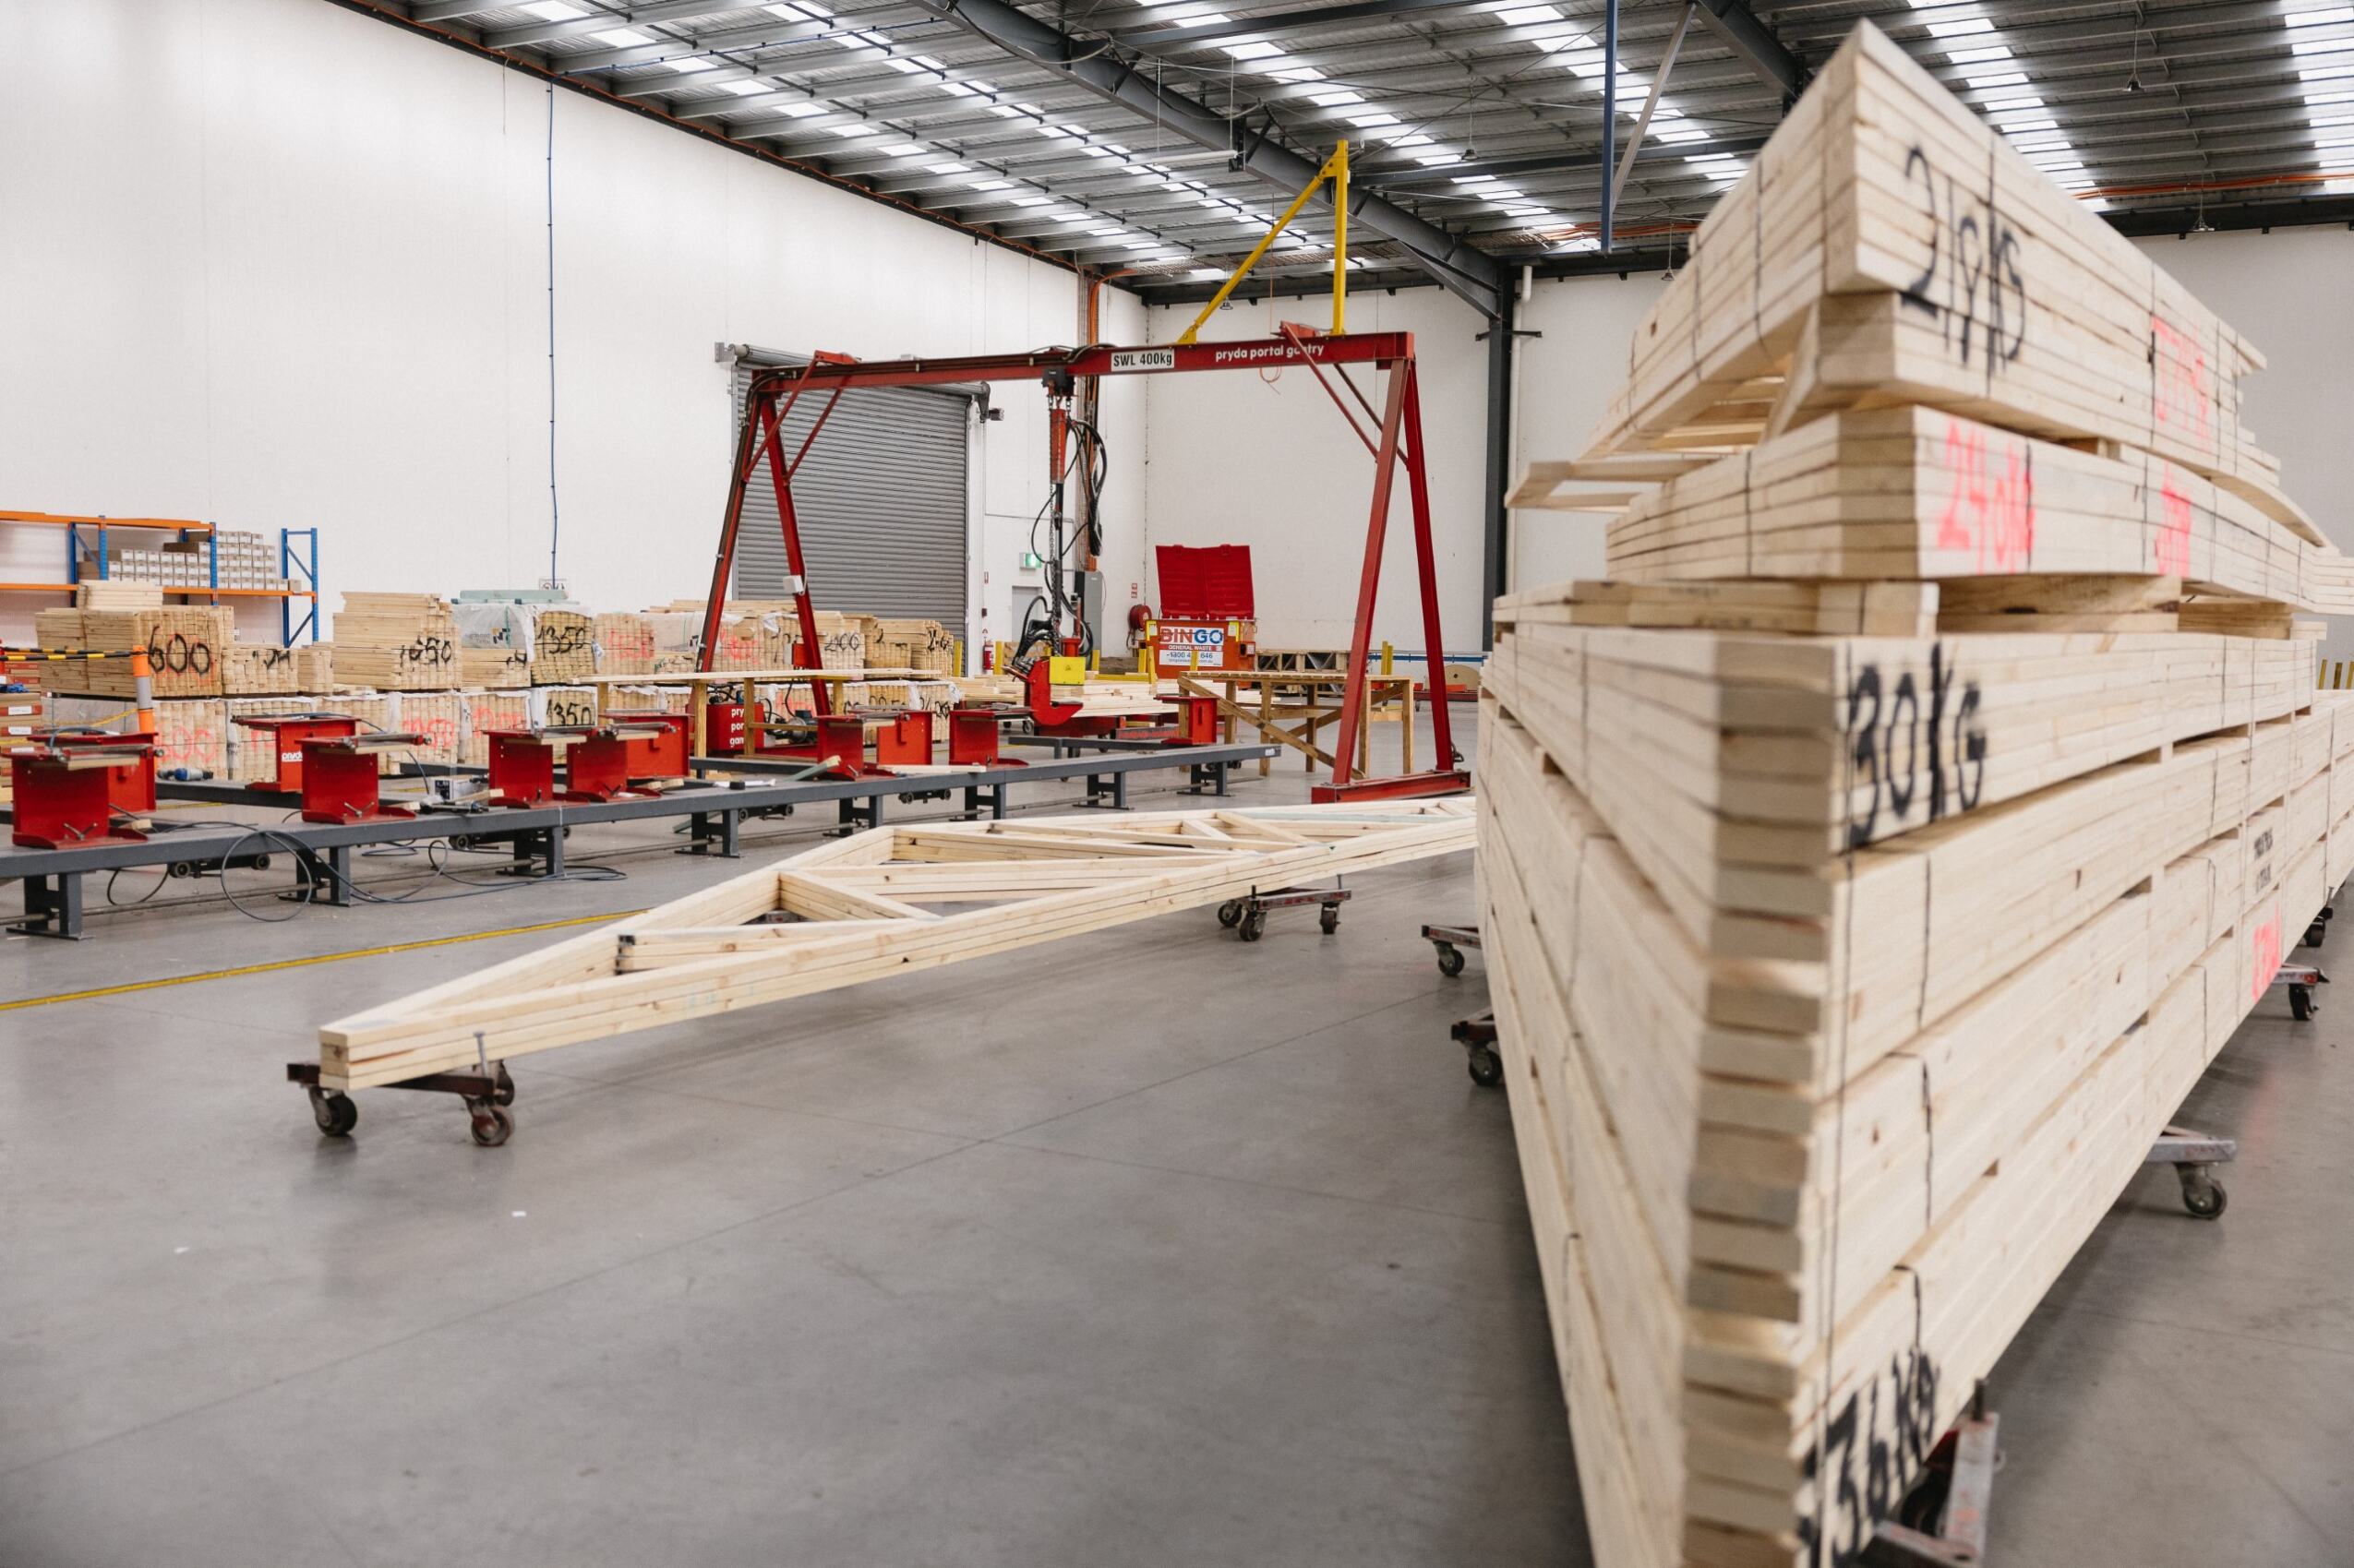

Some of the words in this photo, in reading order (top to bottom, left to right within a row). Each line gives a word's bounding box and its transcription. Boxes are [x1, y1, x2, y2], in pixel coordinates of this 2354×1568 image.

[1113, 354, 1136, 367] SWL
[1139, 353, 1172, 366] 400kg
[1215, 347, 1248, 363] pryda
[1250, 344, 1284, 361] portal
[1160, 628, 1223, 644] BINGO
[148, 625, 210, 675] 600
[546, 699, 595, 726] 1350
